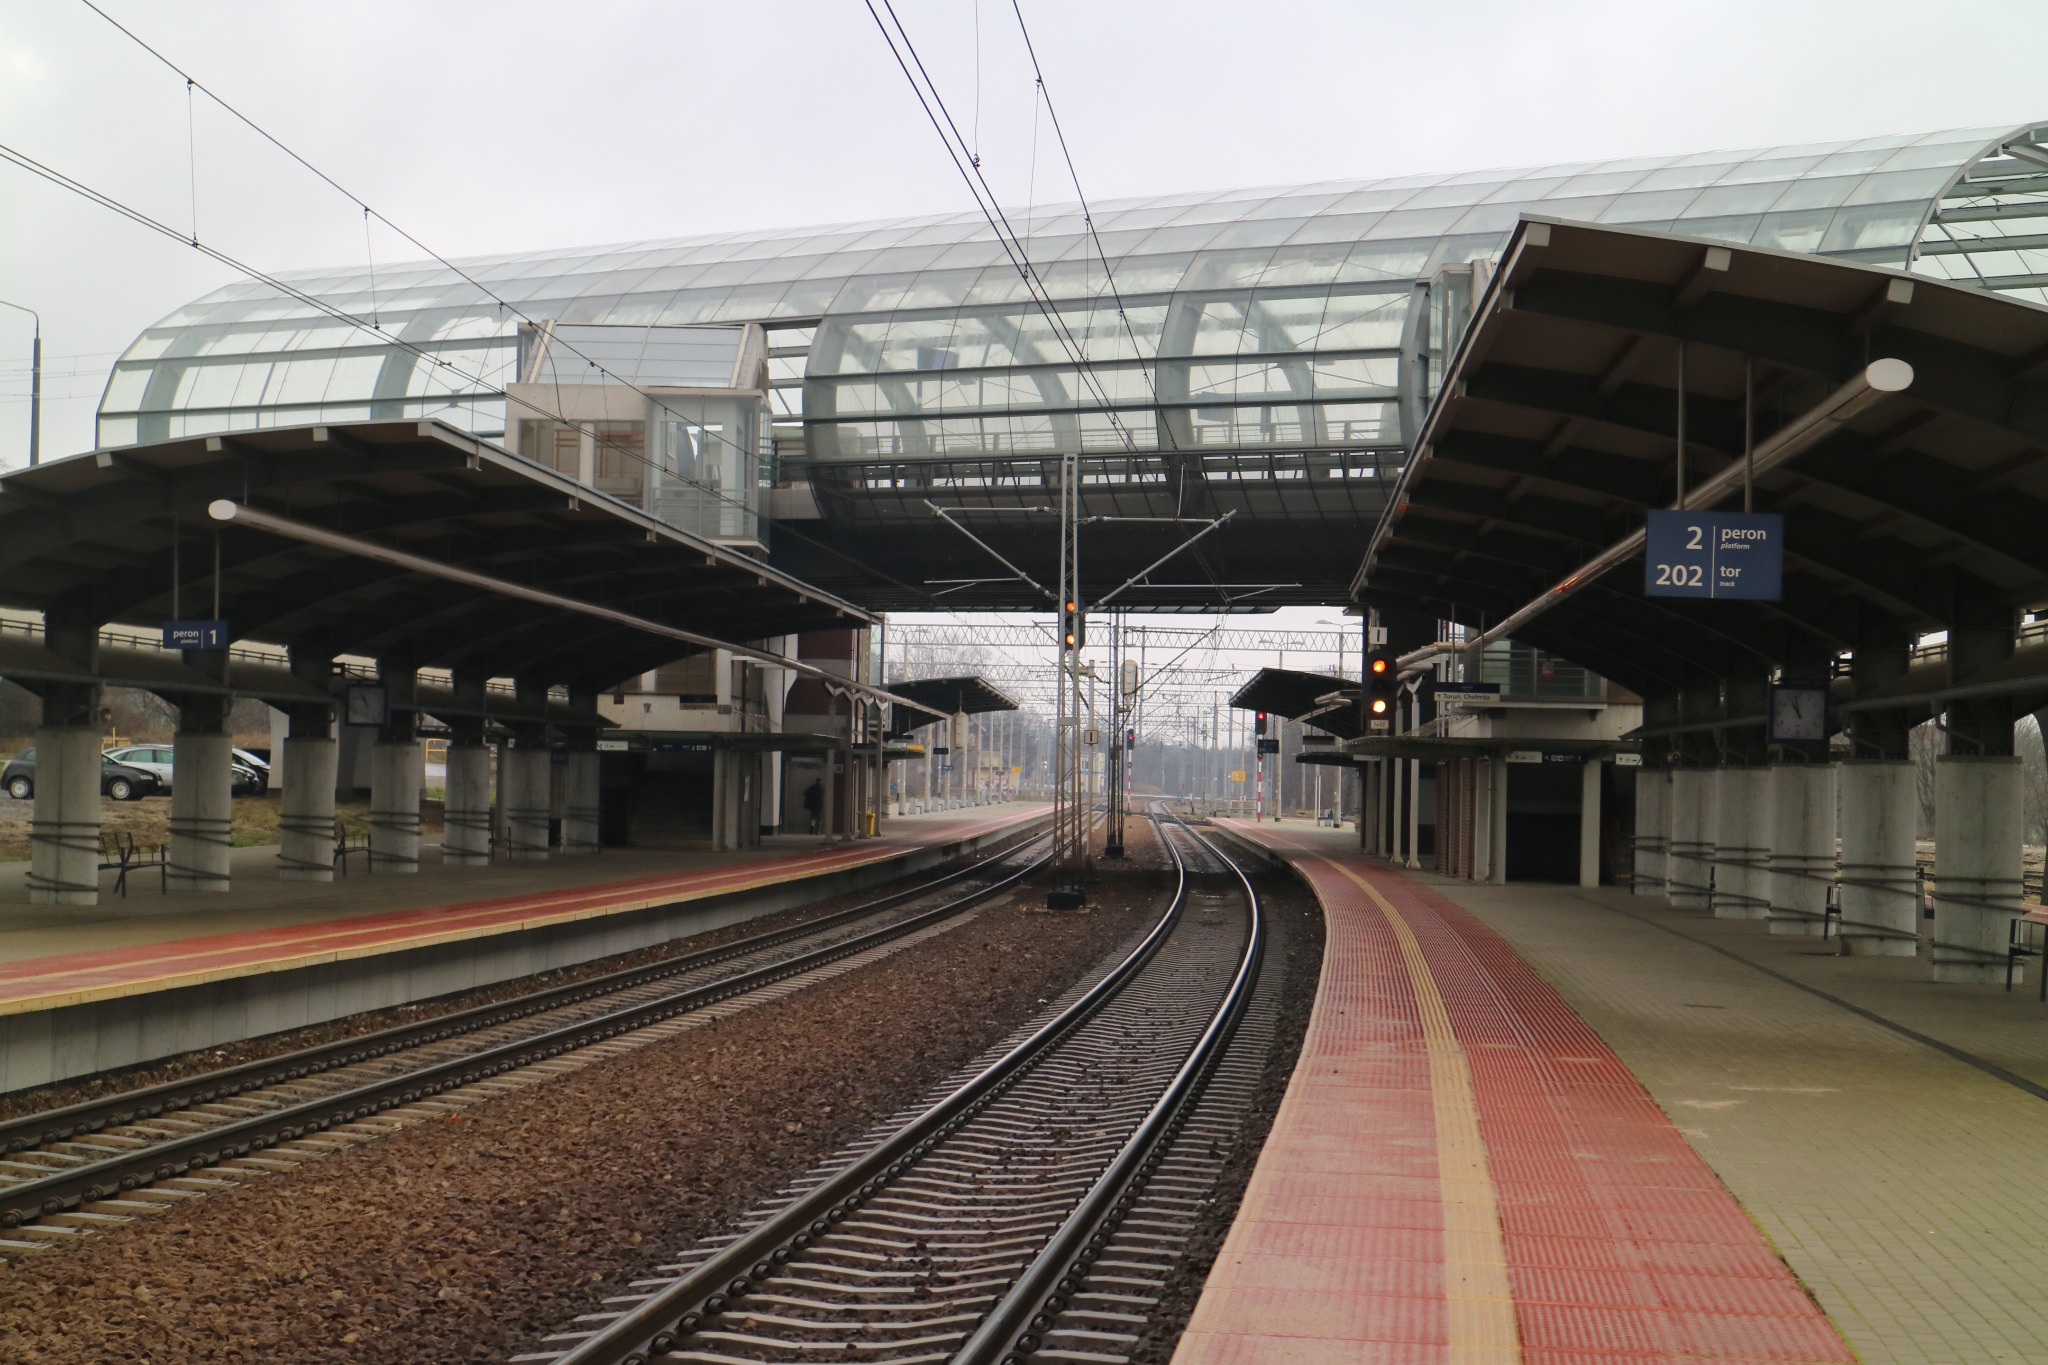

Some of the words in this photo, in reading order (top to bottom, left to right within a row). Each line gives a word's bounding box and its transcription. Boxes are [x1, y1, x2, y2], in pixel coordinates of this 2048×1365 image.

[1686, 526, 1703, 550] 2
[1721, 528, 1767, 542] peron
[1720, 542, 1751, 550] platform
[1655, 564, 1703, 587] 202
[1720, 565, 1741, 578] tor
[173, 630, 199, 640] peron
[209, 629, 217, 645] 1
